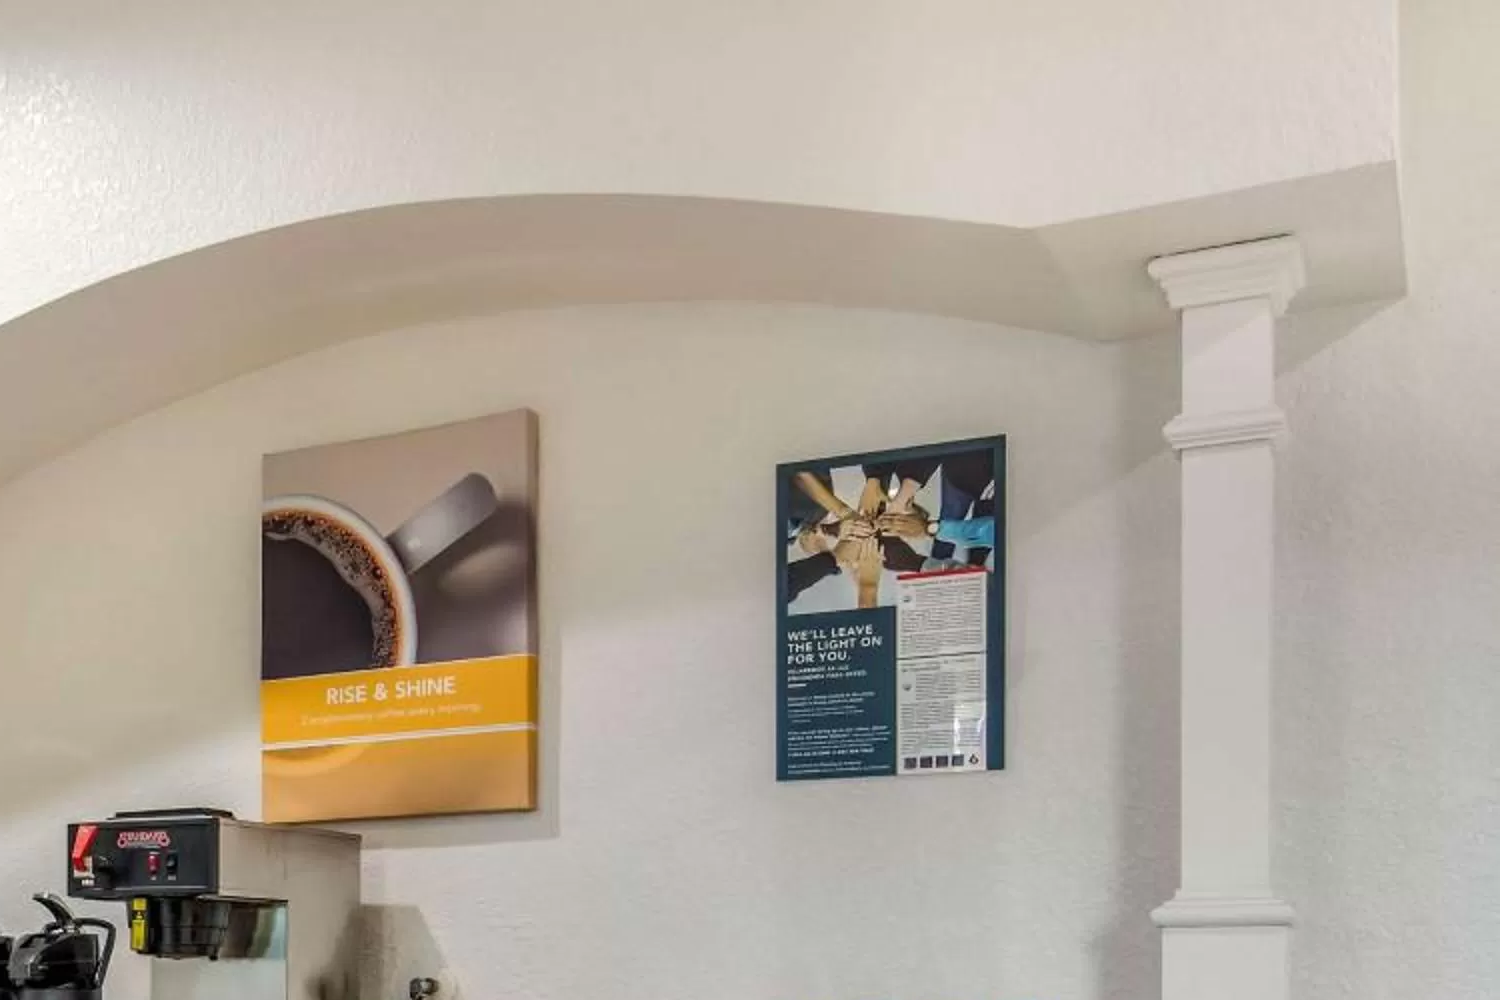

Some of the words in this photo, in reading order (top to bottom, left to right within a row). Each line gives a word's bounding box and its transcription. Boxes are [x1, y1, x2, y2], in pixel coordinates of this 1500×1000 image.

[787, 629, 827, 641] WE'LL
[831, 624, 873, 638] LEAVE
[787, 641, 813, 653] THE
[817, 637, 857, 651] LIGHT
[861, 635, 883, 648] ON
[787, 653, 814, 665] FOR
[326, 686, 368, 705] RISE
[373, 682, 389, 701] &
[395, 675, 457, 699] SHINE
